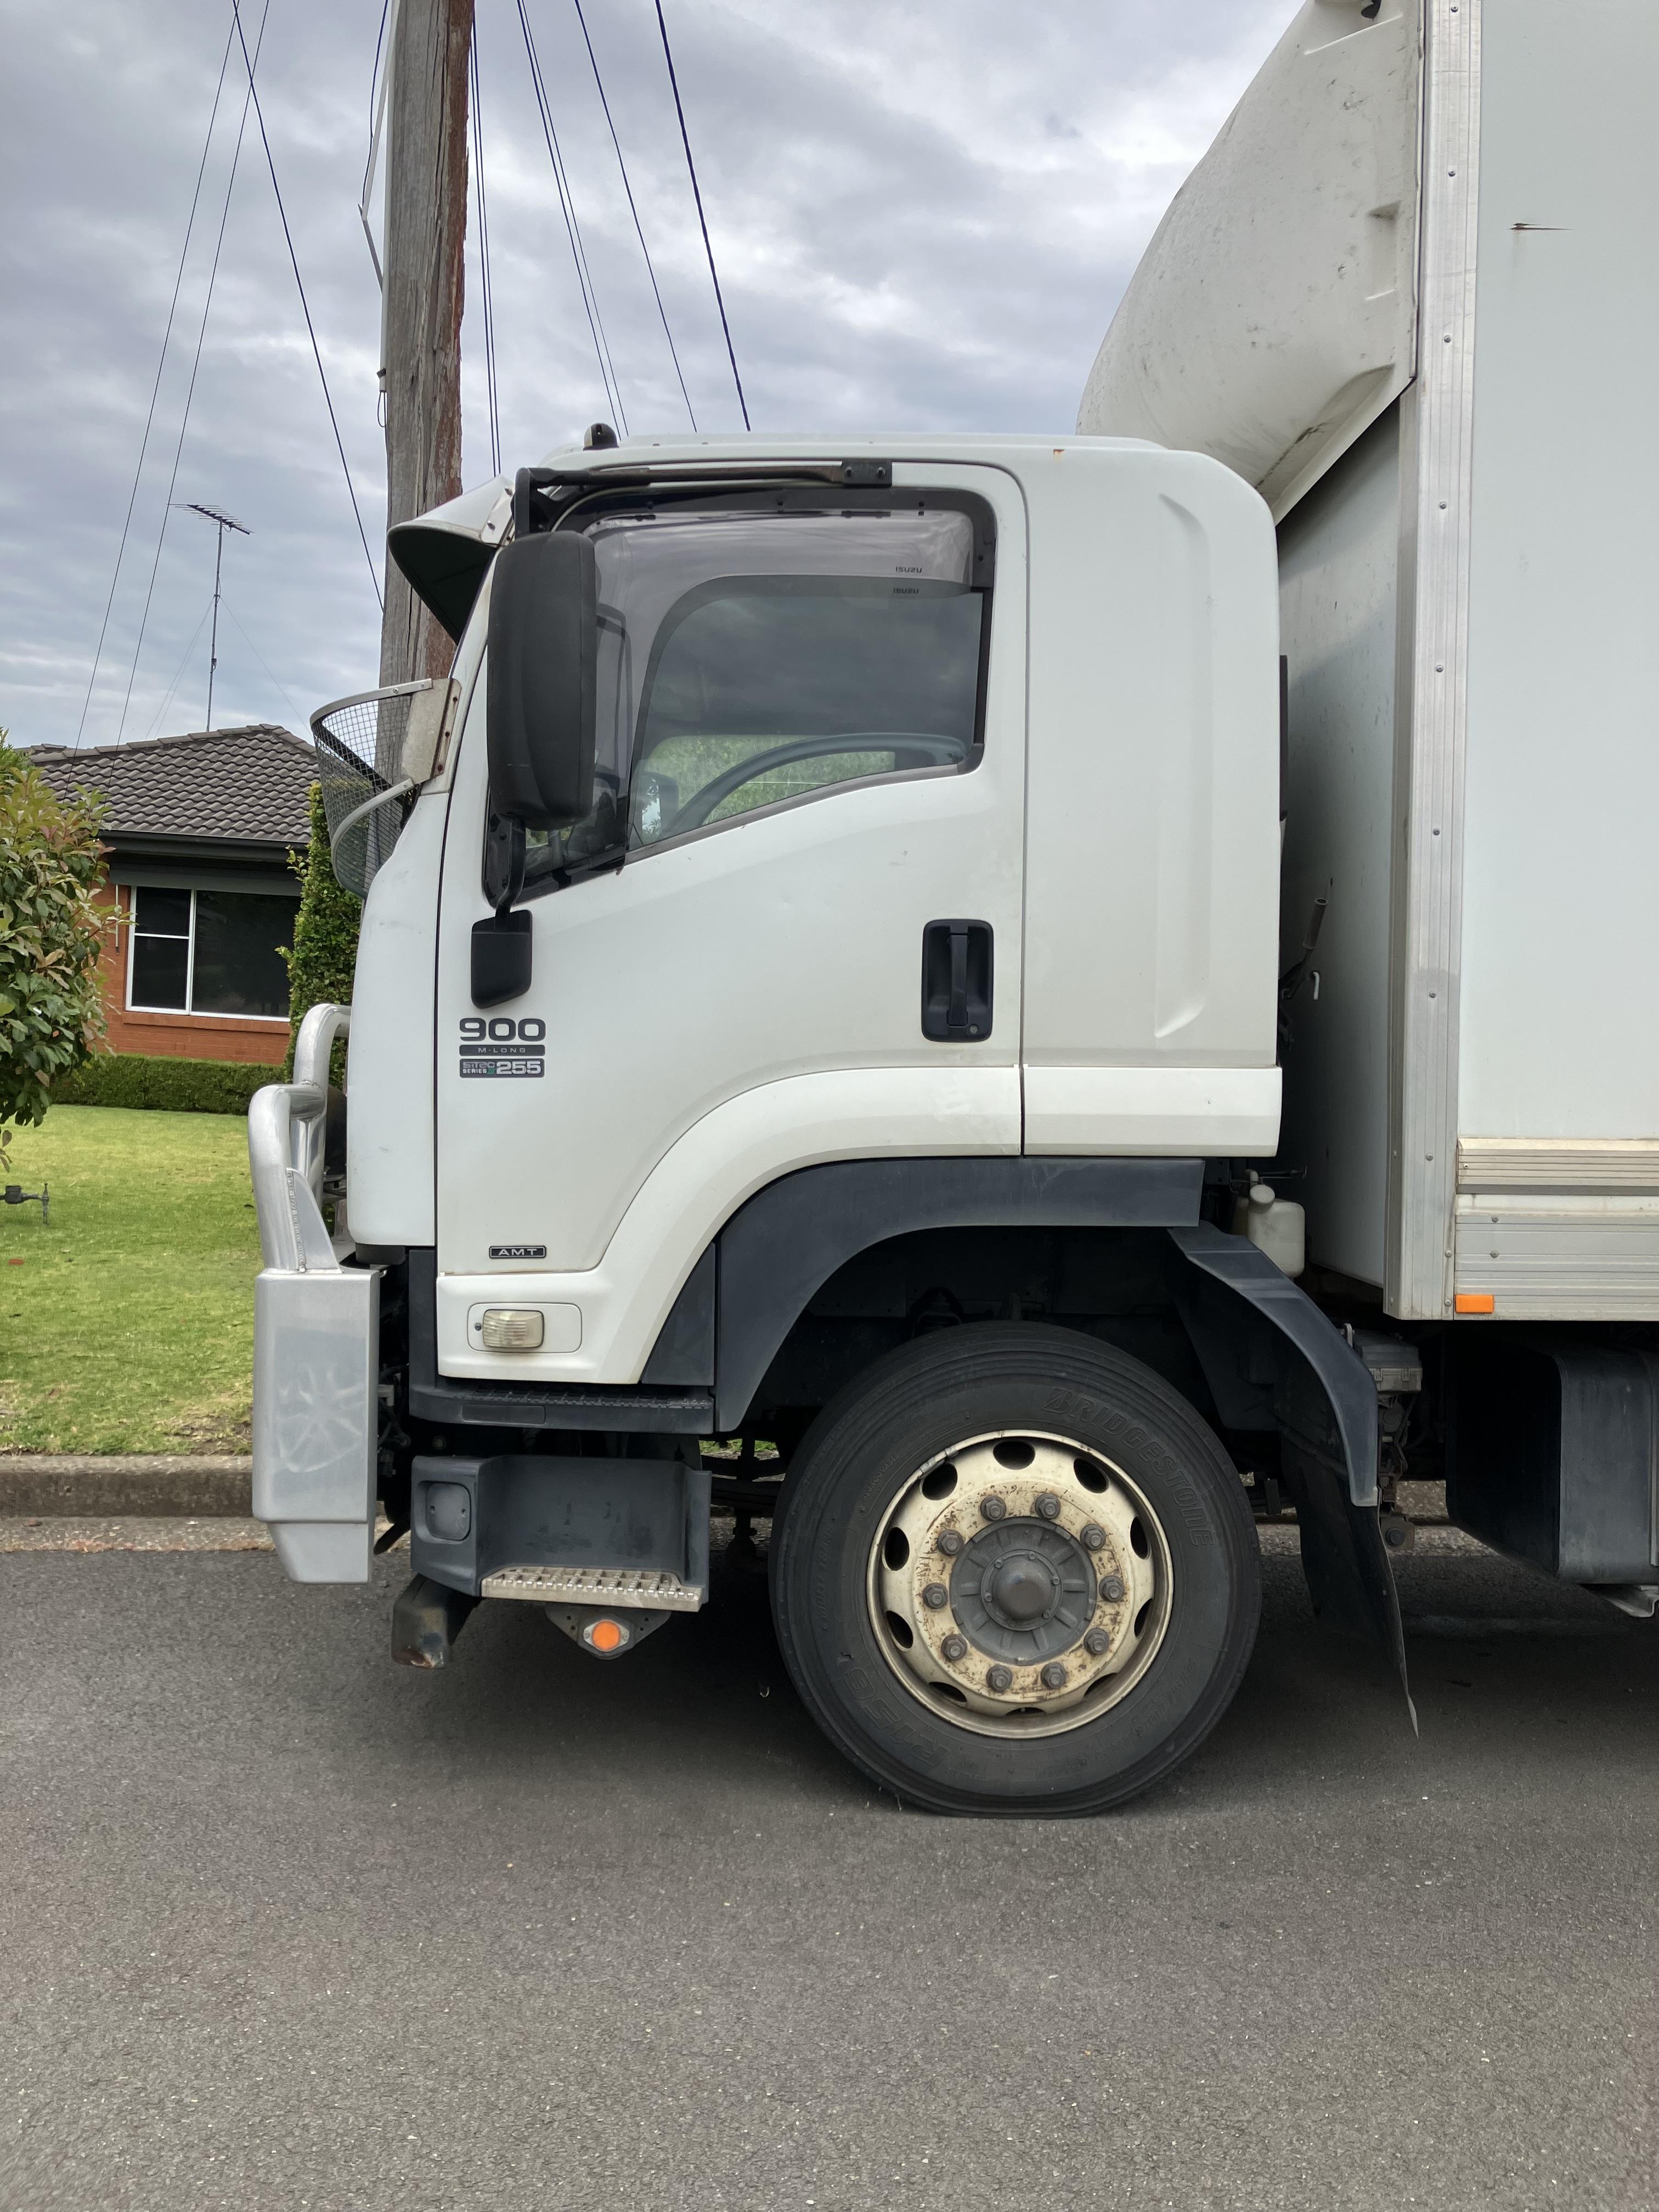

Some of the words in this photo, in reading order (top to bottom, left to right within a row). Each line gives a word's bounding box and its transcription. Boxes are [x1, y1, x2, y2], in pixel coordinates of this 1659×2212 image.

[459, 1018, 546, 1042] 900
[496, 1060, 541, 1075] 255
[1042, 1387, 1215, 1546] BRIDGESTONE
[842, 1667, 950, 1767] R156
